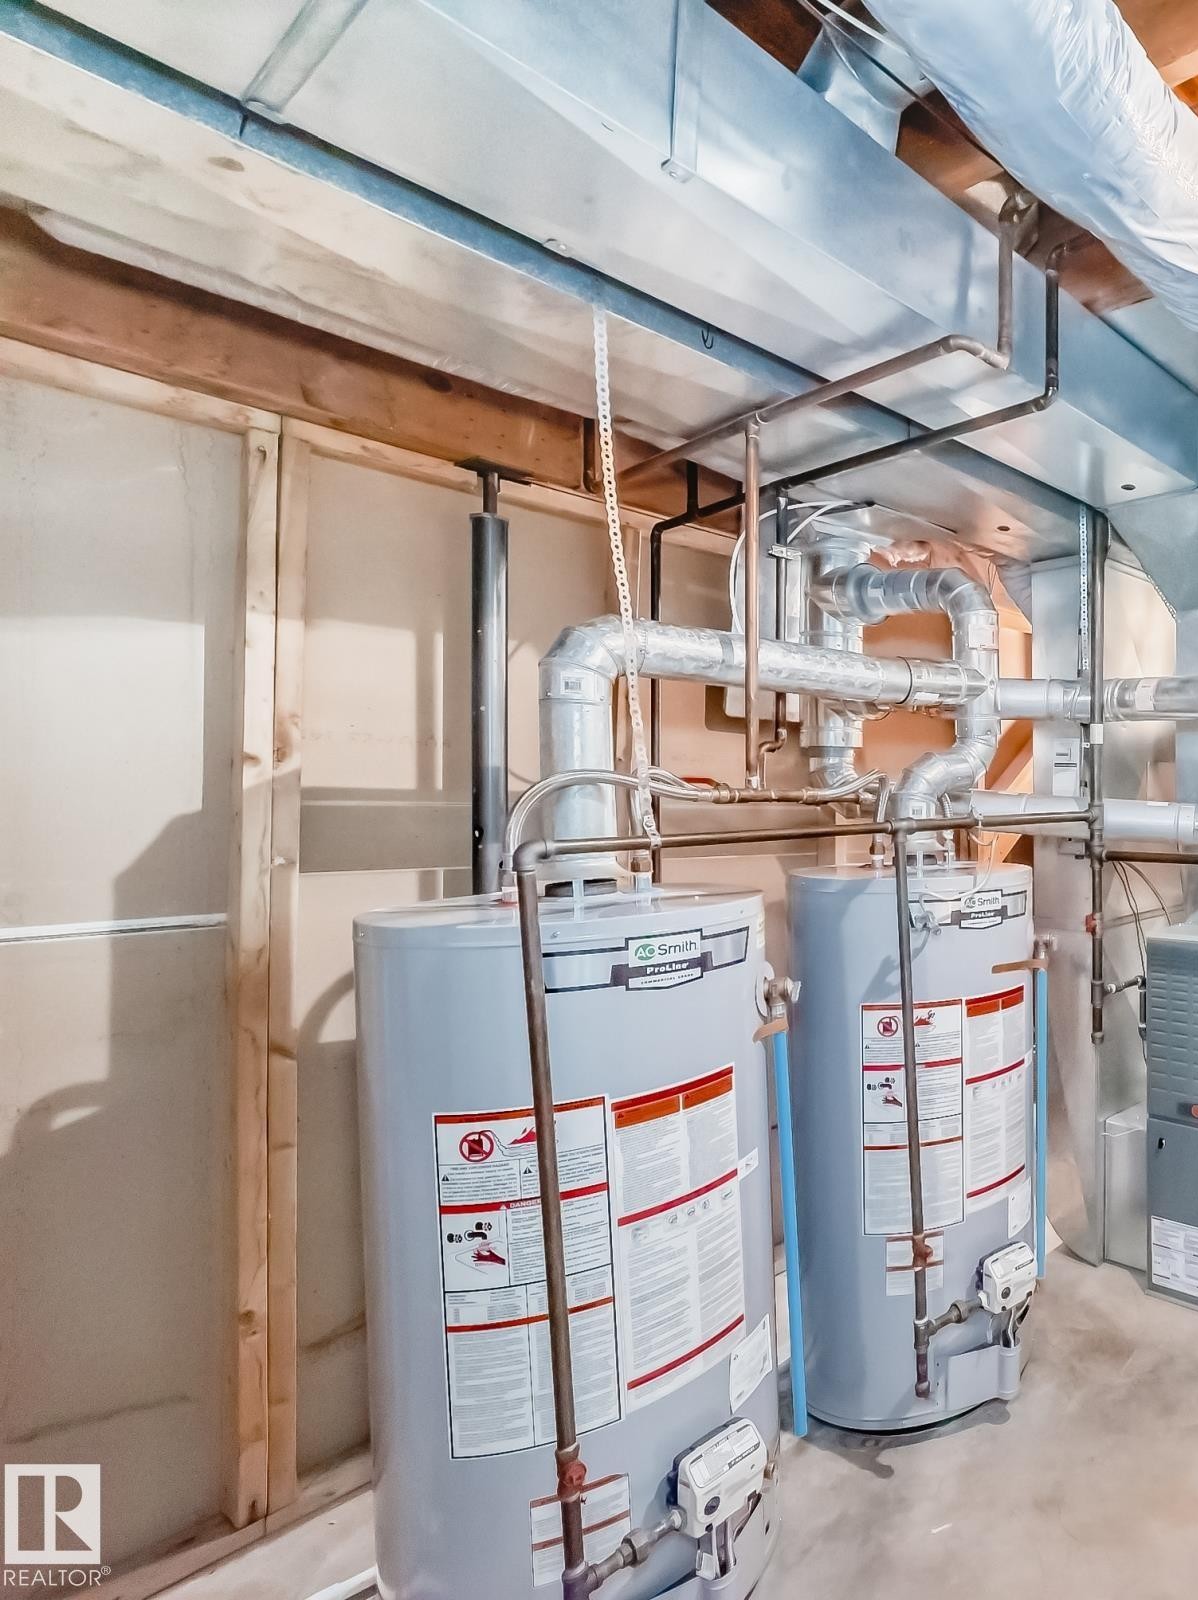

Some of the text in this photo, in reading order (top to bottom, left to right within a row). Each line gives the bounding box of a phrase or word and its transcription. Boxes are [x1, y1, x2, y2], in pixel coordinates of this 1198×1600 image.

[977, 896, 1000, 907] Smith
[658, 940, 697, 956] Smith
[646, 962, 689, 975] ProLine
